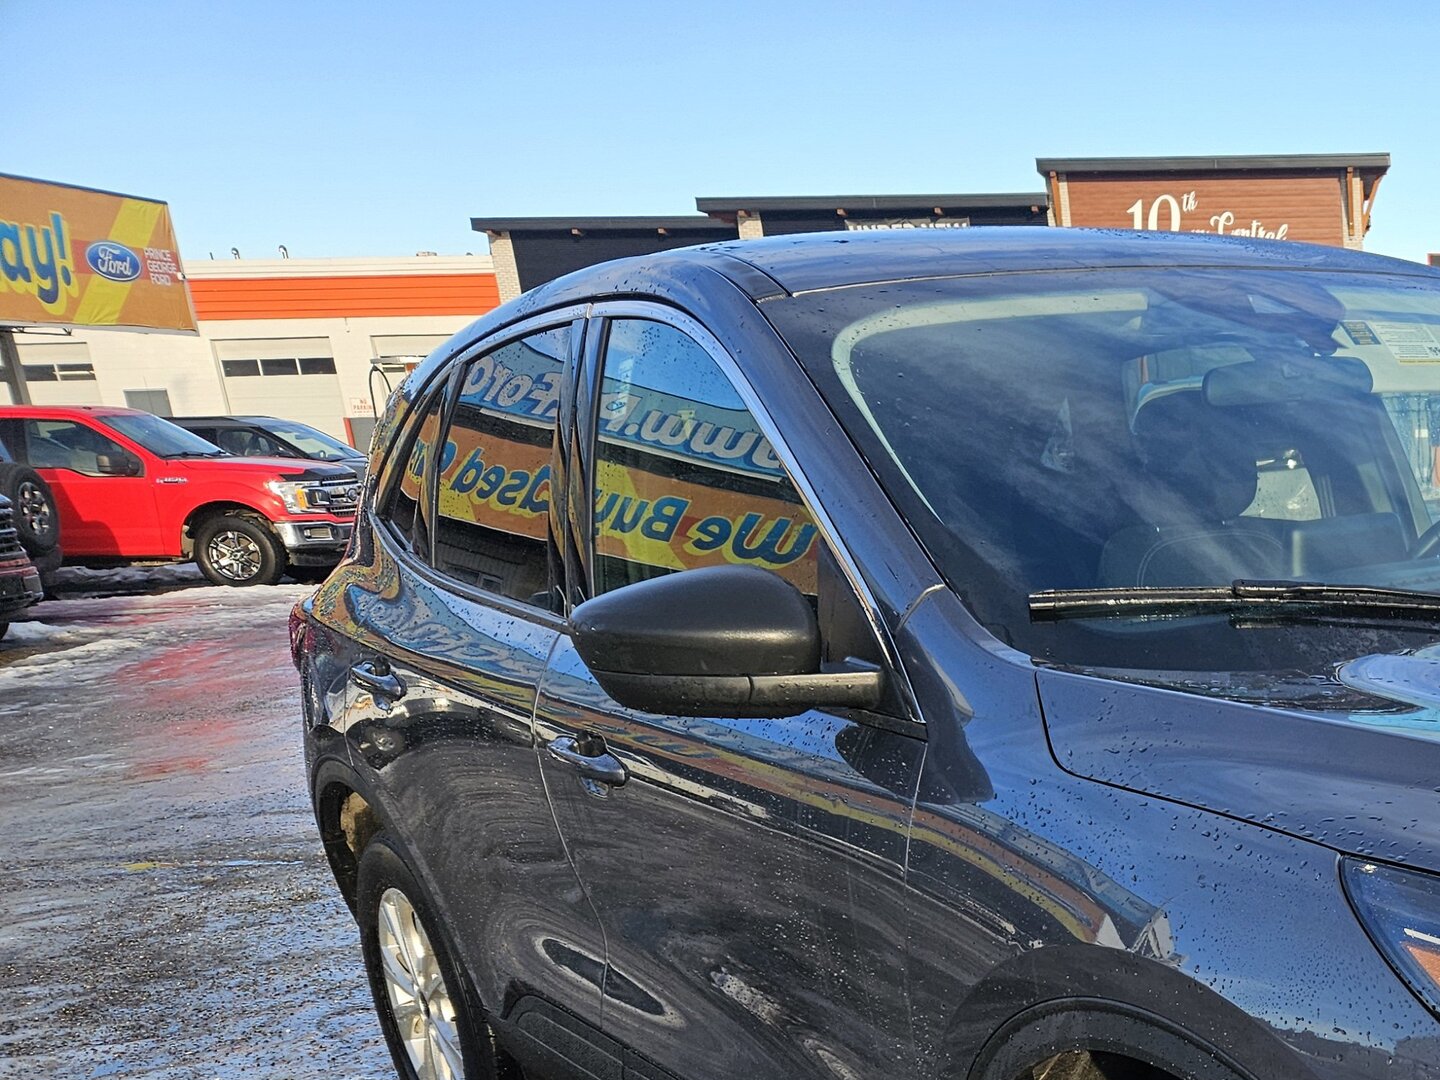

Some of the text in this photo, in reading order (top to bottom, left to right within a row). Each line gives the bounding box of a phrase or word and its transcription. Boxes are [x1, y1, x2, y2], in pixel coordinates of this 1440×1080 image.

[0, 211, 72, 305] ay!
[143, 247, 173, 262] PRINCE
[146, 260, 177, 275] GEORGE
[150, 272, 171, 286] FORD
